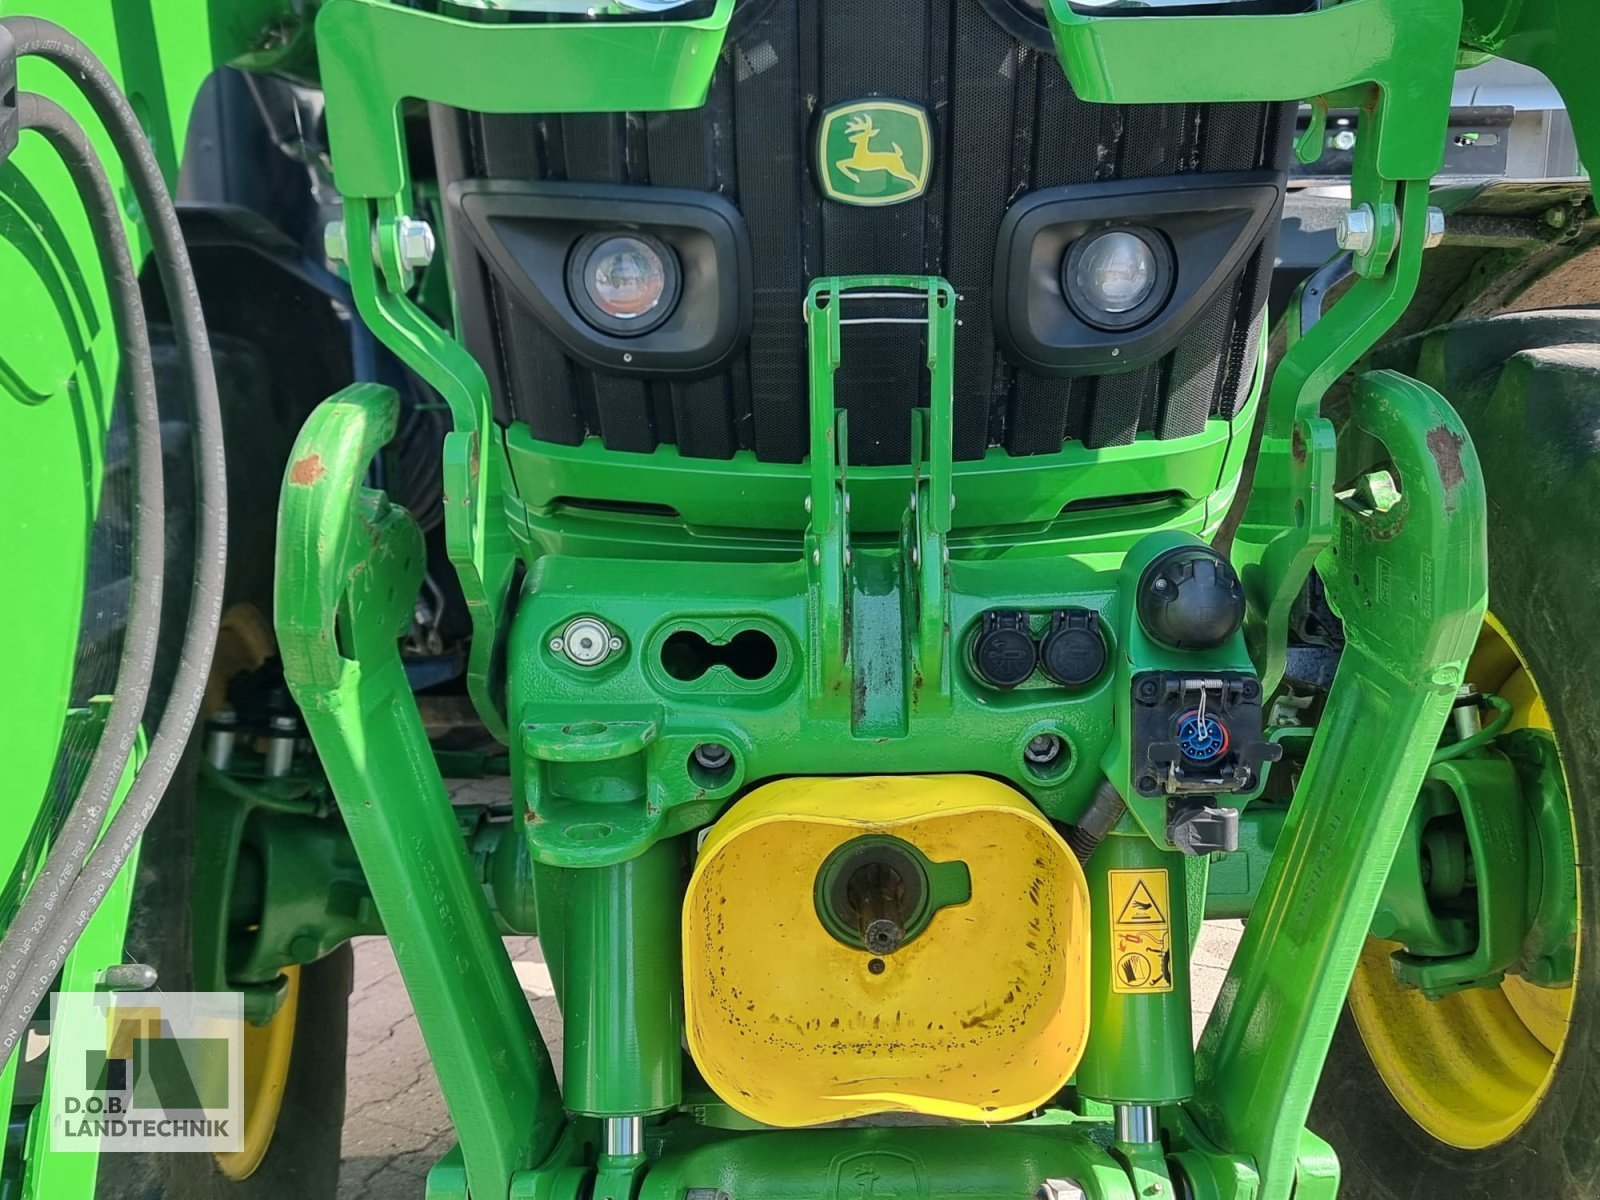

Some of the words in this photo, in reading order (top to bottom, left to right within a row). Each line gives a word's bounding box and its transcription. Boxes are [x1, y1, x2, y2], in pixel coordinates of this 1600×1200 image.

[4, 1028, 17, 1047] DN
[19, 1004, 31, 1021] 10
[75, 909, 88, 927] WP
[87, 882, 105, 905] 330
[104, 821, 141, 878] BAR/4785
[140, 793, 156, 819] PSI
[162, 752, 177, 774] ISO
[30, 913, 46, 934] 330
[43, 861, 74, 911] BAR/4785
[70, 839, 86, 858] PSI
